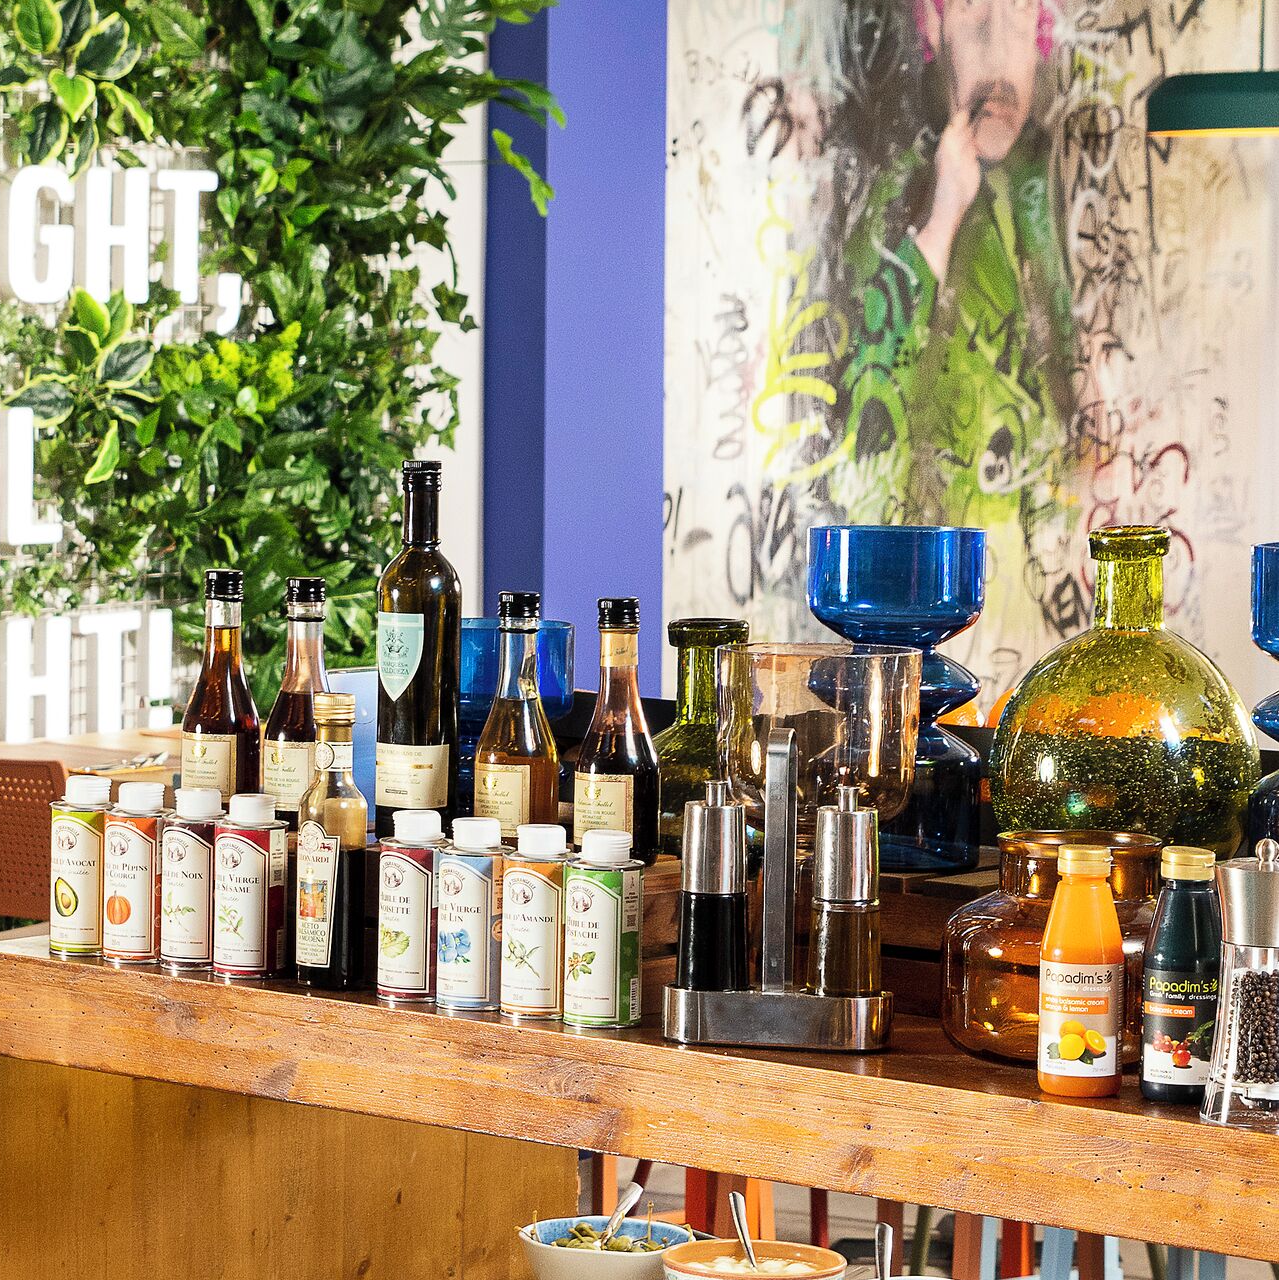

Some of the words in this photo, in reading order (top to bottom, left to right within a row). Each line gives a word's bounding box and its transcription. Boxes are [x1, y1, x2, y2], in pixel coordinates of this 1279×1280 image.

[181, 870, 204, 880] NOIX
[228, 873, 260, 884] VIERGE
[399, 895, 411, 904] DE
[450, 901, 482, 914] VIERGE
[449, 912, 464, 922] LIN
[588, 921, 600, 929] DE
[1045, 968, 1104, 984] Papadim's
[1149, 976, 1209, 993] Papadim's
[1165, 992, 1185, 1001] family
[1188, 993, 1218, 1001] dressings
[1069, 1005, 1089, 1013] lemon
